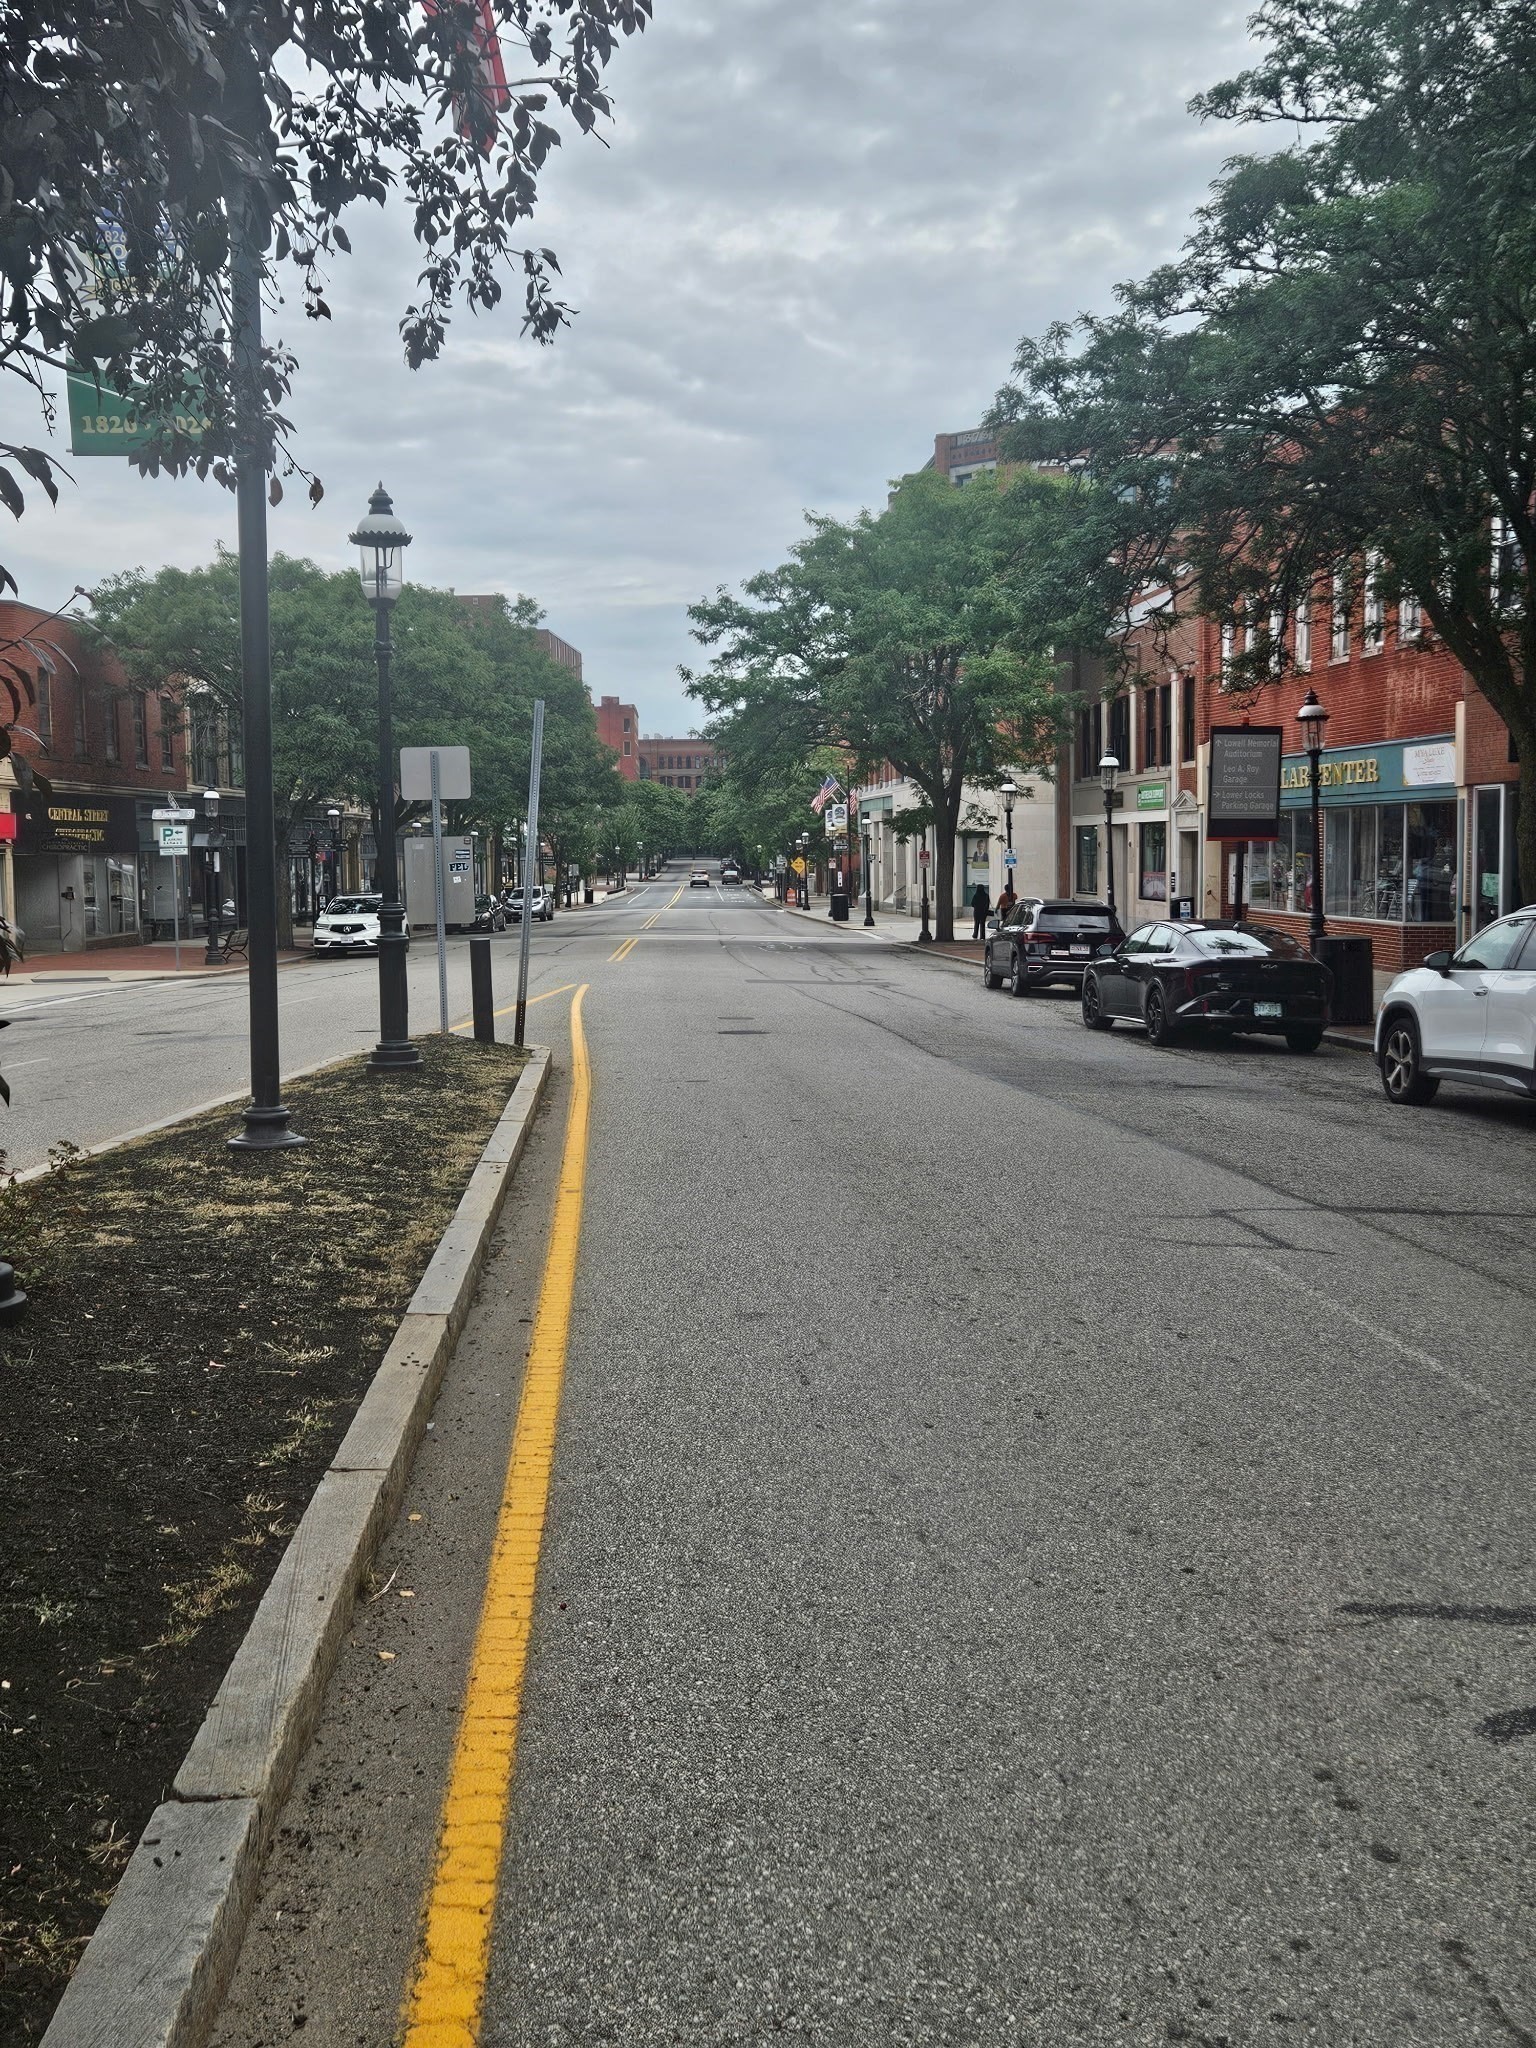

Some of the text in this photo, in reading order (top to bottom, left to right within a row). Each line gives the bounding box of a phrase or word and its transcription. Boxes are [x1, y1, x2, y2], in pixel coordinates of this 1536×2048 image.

[81, 416, 138, 434] 1826
[1224, 739, 1279, 747] Lowell Memorial
[1224, 749, 1263, 758] Auditorium
[1223, 765, 1236, 773] Leo
[1247, 765, 1260, 775] Roy
[1318, 758, 1379, 787] ENTER
[1223, 775, 1248, 785] Garage
[1222, 791, 1264, 799] Lower Locks
[1221, 801, 1274, 811] Parking Garage
[48, 807, 109, 821] CENTRAL STREET
